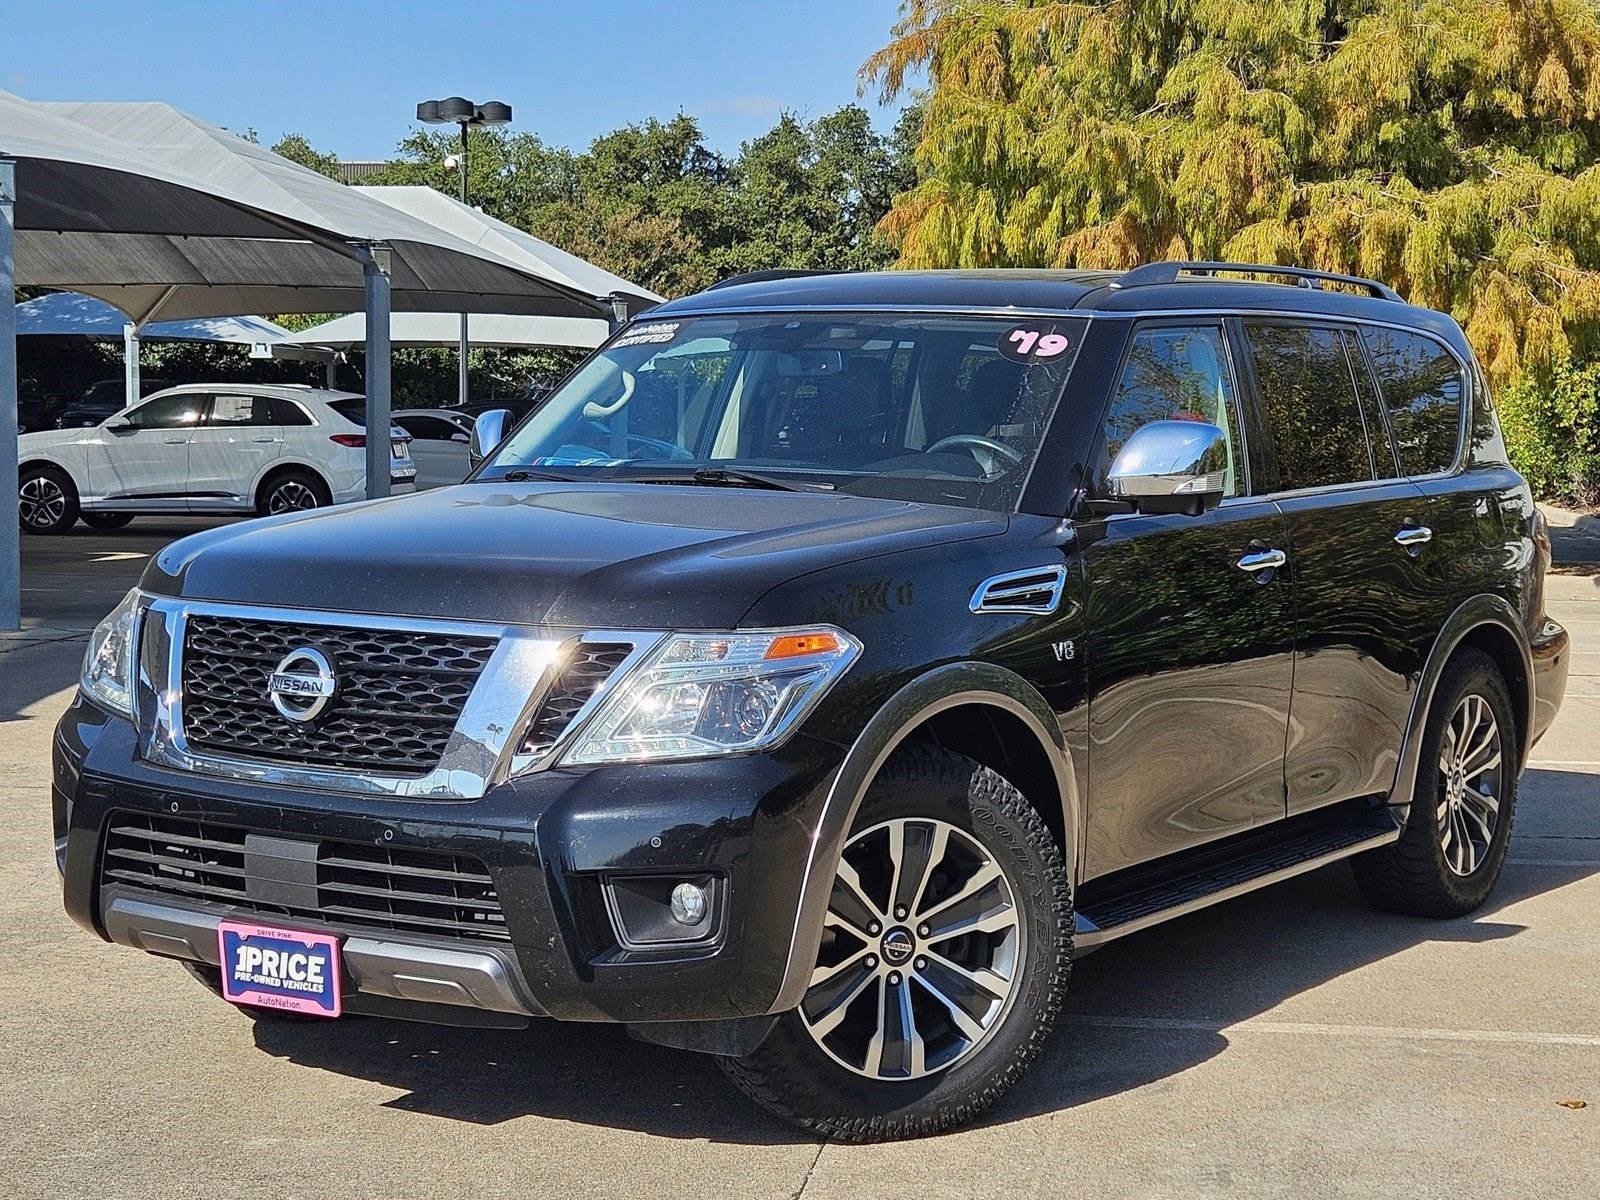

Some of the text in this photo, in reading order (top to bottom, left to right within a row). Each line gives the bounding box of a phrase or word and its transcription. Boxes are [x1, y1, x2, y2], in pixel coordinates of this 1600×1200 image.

[1051, 640, 1075, 661] V8
[271, 678, 324, 693] NISSAN
[256, 929, 293, 939] DRIVE PINK
[235, 945, 326, 984] 1PRICE
[234, 971, 324, 994] PRE-OWNED VEHICLES
[257, 995, 302, 1009] AutoNation
